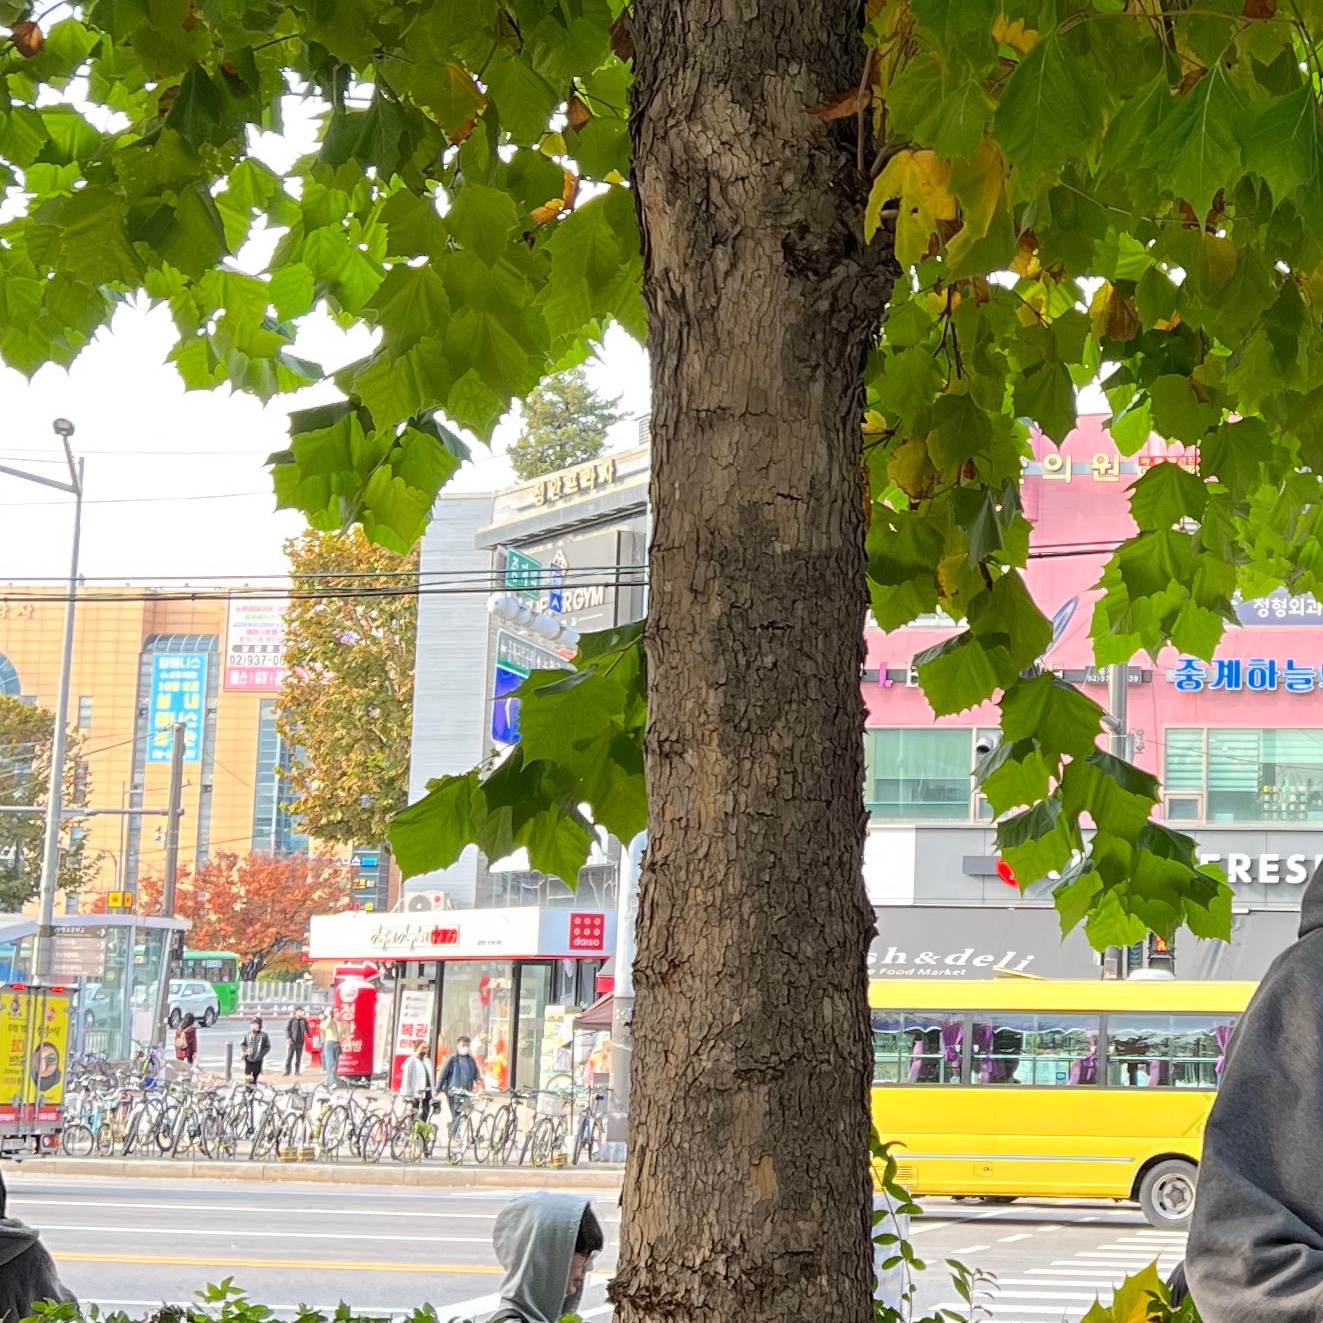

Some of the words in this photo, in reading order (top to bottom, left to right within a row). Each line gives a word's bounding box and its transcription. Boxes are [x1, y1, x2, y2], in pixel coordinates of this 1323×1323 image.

[1020, 453, 1120, 484] 의원
[1253, 598, 1322, 618] 정형외과
[1200, 853, 1323, 884] RES
[879, 968, 915, 976] Food
[919, 968, 967, 976] Market
